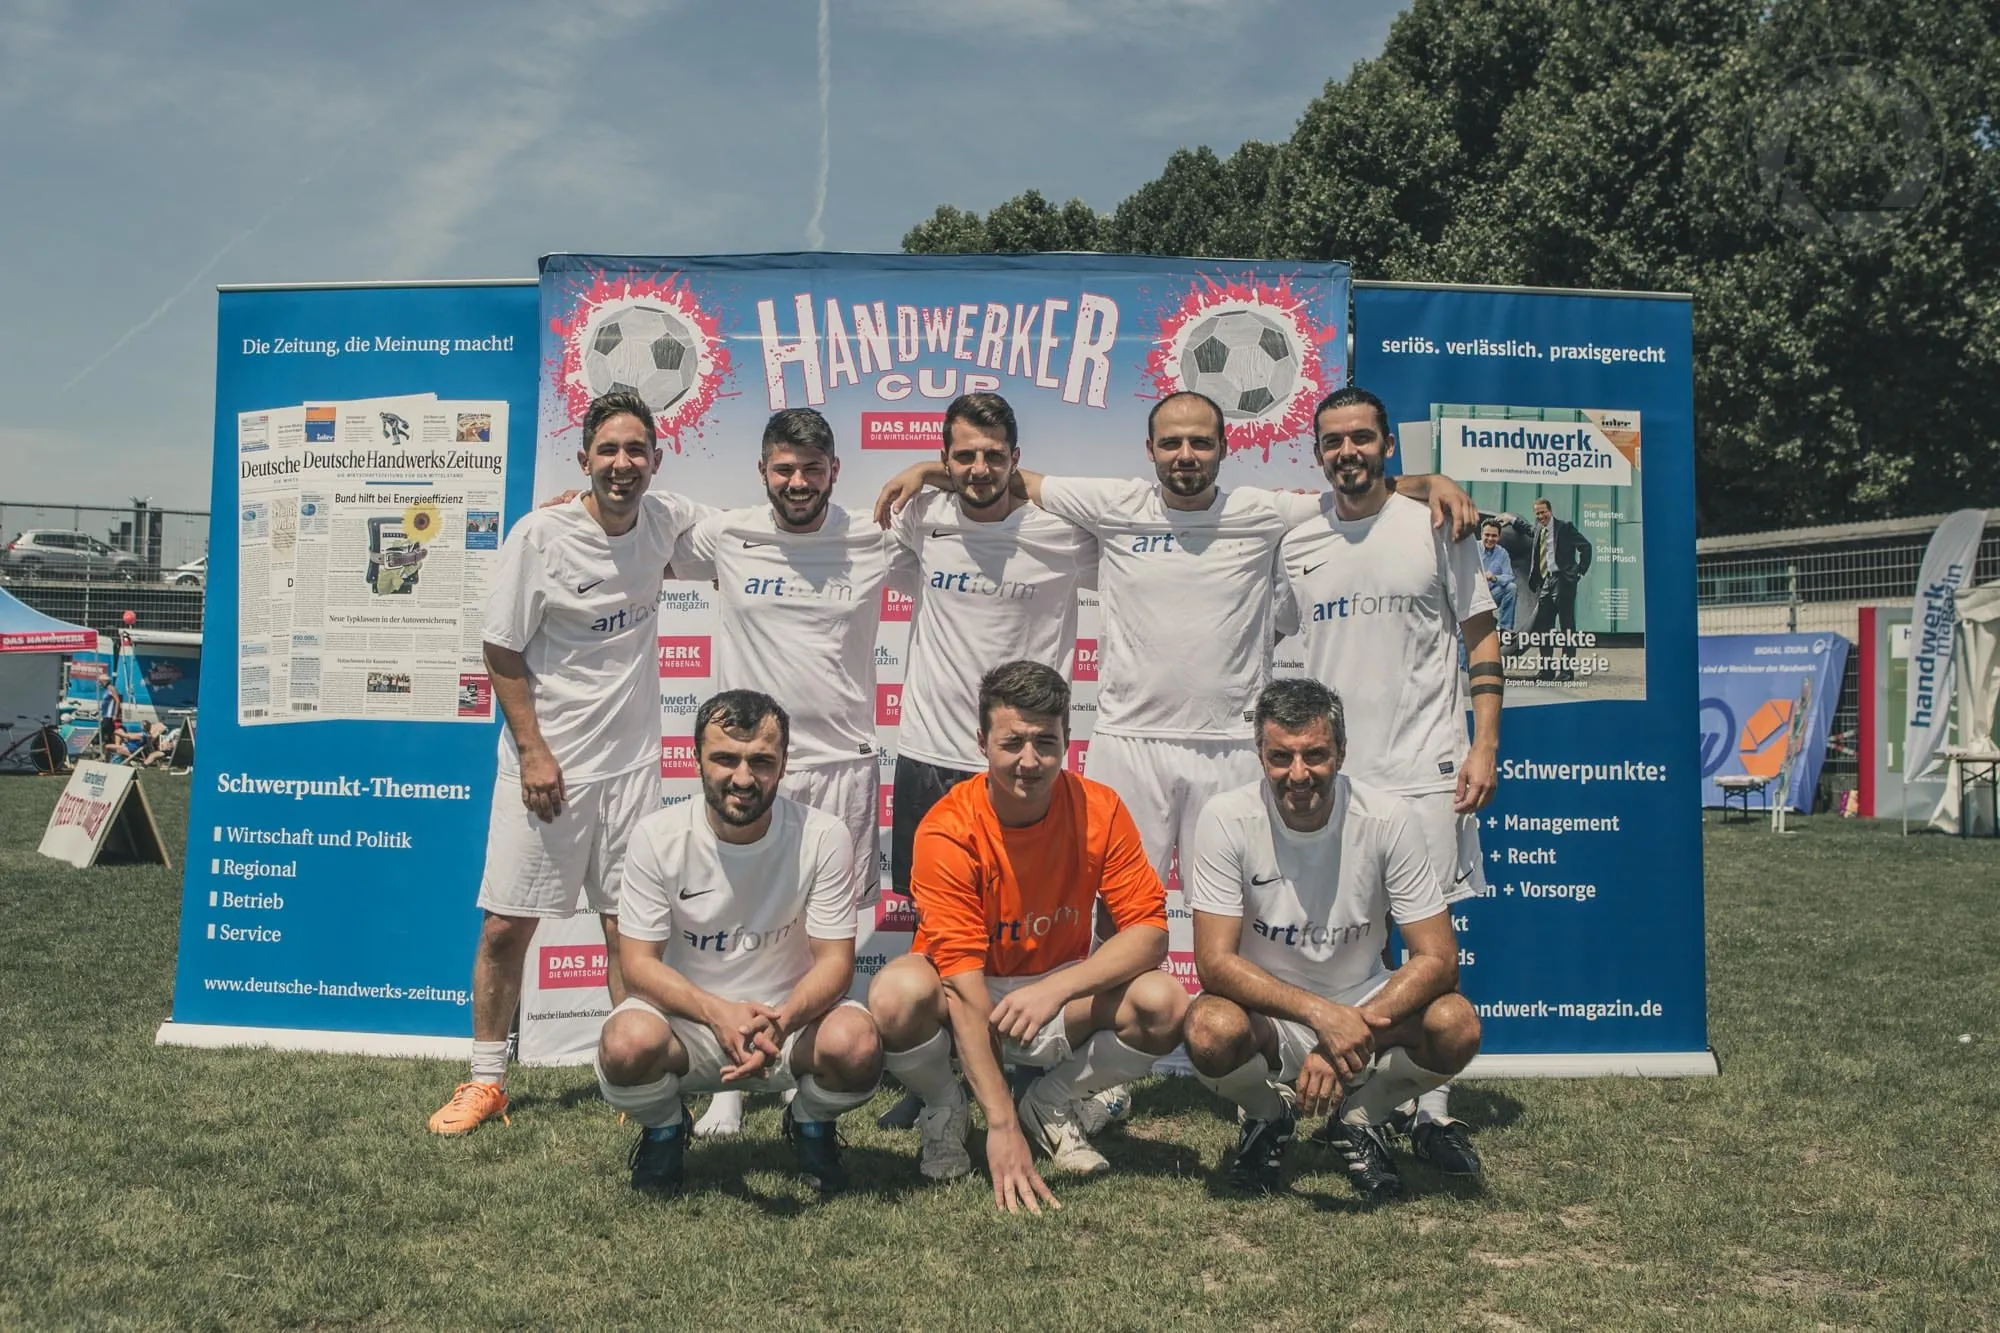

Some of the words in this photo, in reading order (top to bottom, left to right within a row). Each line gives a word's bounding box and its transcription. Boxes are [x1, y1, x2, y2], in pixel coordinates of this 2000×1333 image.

[242, 339, 270, 354] Die
[273, 338, 340, 356] Zeitung,
[345, 337, 370, 352] die
[375, 336, 450, 355] Meinung
[454, 336, 514, 351] macht!
[757, 293, 1120, 410] HANDWERKER
[1381, 337, 1440, 354] seriös.
[1446, 340, 1543, 359] verlässlich.
[1550, 343, 1666, 364] praxisgerecht
[875, 367, 1002, 400] CUP
[870, 421, 904, 433] DAS
[909, 421, 944, 433] HAN
[1461, 425, 1592, 451] handwerk
[241, 456, 300, 479] Deutsche
[1527, 449, 1612, 473] magazin
[335, 493, 356, 503] Bund
[358, 493, 375, 503] hilft
[377, 493, 391, 503] bei
[394, 493, 464, 505] Energieeffizienz
[666, 599, 710, 612] magazin
[1313, 592, 1415, 621] artform
[390, 615, 400, 623] der
[1519, 628, 1597, 648] perfekte
[1910, 583, 1945, 728] handwerk
[1505, 678, 1535, 688] Experten
[1536, 679, 1562, 688] Steuern
[1496, 760, 1667, 784] -Schwerpunkte:
[218, 773, 471, 800] Schwerpunkt-Themen:
[1504, 815, 1620, 835] Management
[227, 827, 313, 845] Wirtschaft
[318, 831, 352, 847] und
[356, 831, 412, 848] Politik
[1508, 848, 1557, 864] Recht
[223, 859, 297, 880] Regional
[222, 892, 284, 910] Betrieb
[1520, 881, 1596, 901] Vorsorge
[220, 924, 281, 942] Service
[549, 956, 585, 969] DAS
[549, 970, 561, 979] DIE
[204, 977, 474, 1006] www.deutsche-handwerks-zeitung.
